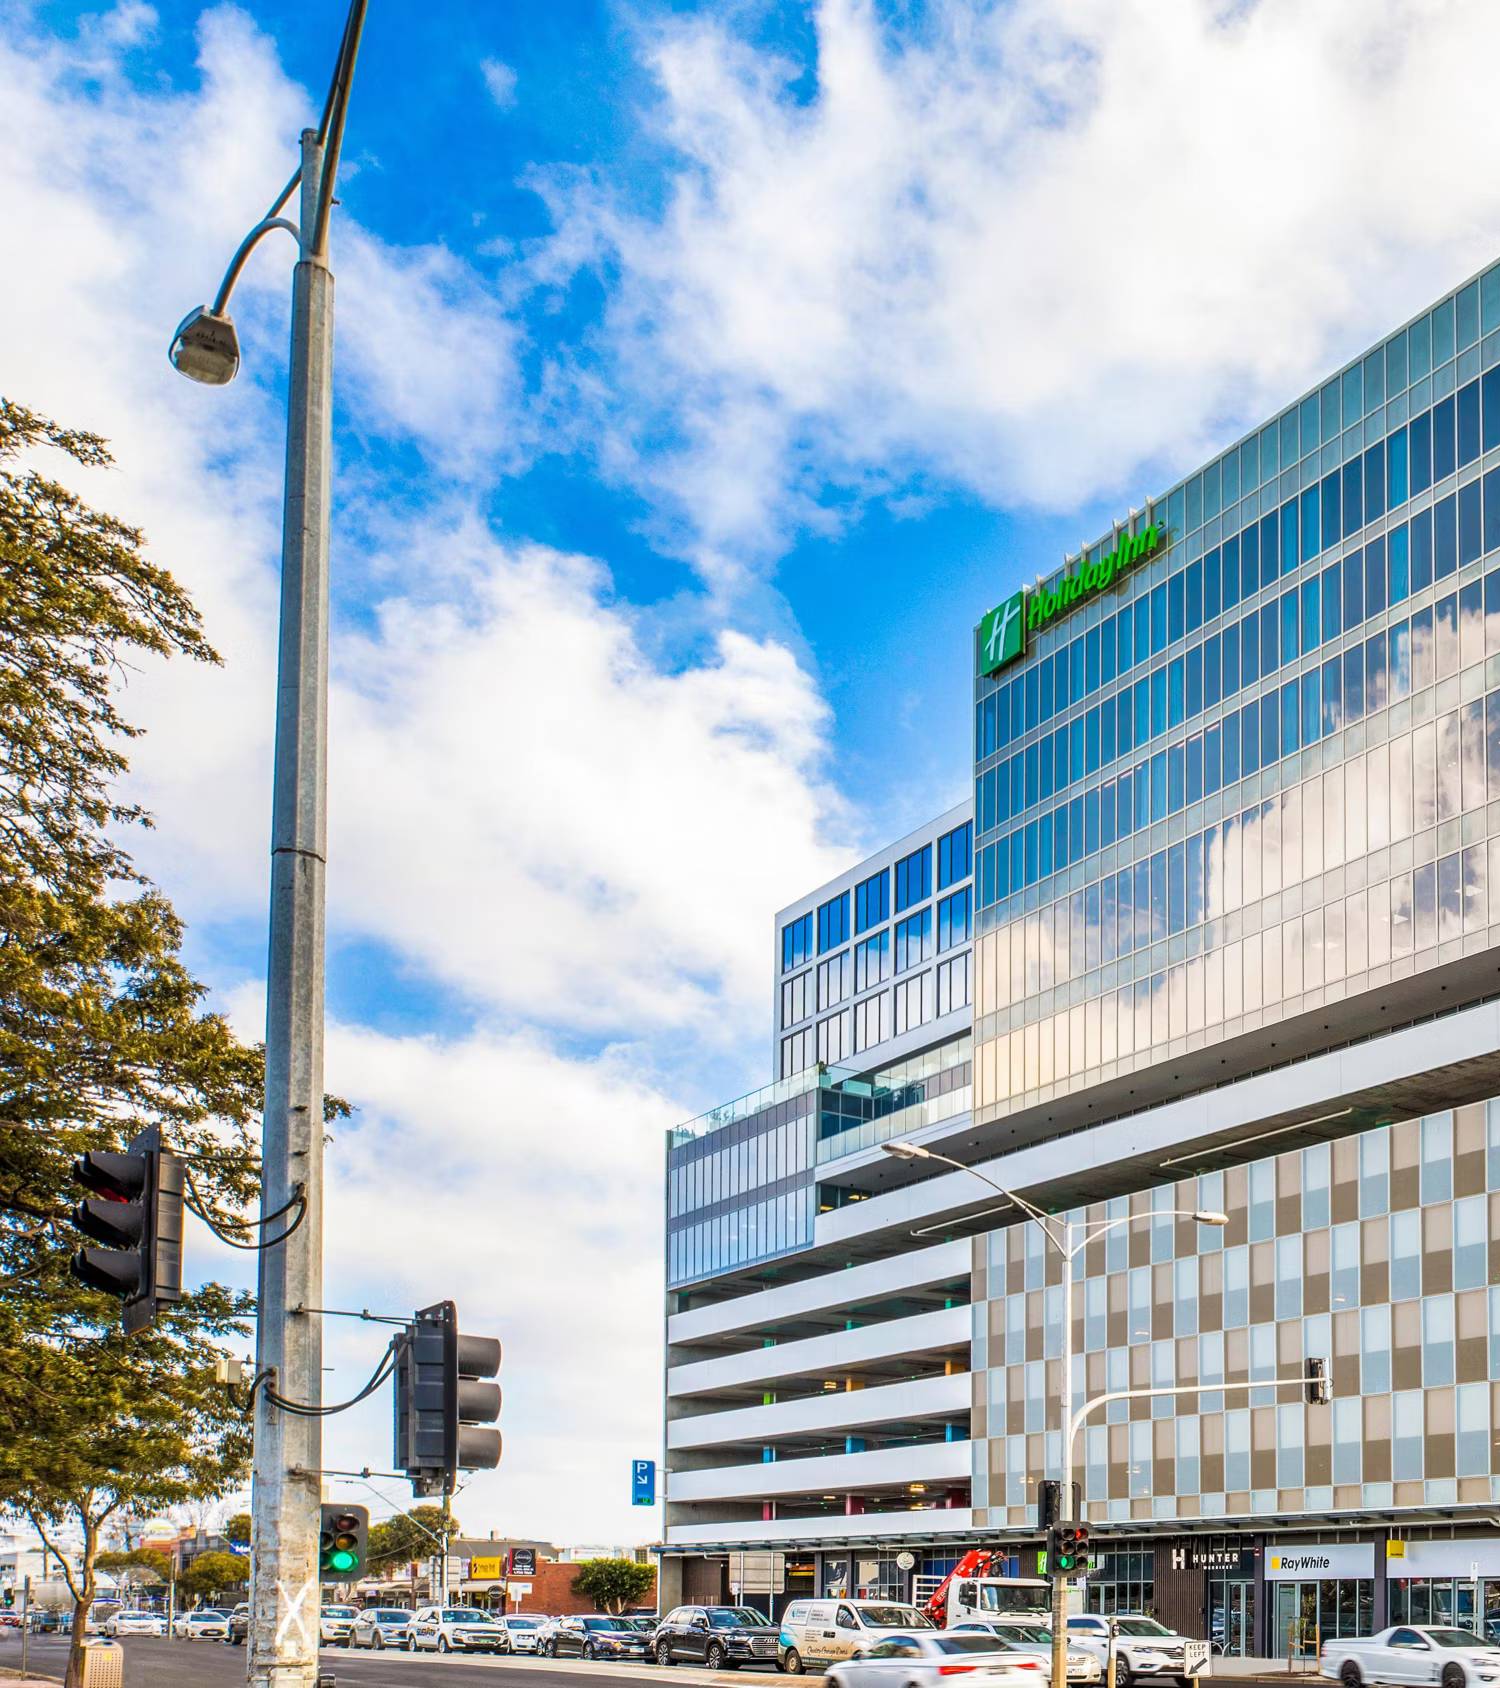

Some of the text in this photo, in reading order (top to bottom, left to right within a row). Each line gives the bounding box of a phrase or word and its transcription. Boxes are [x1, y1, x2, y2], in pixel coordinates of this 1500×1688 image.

[1027, 523, 1160, 630] Holiday Inn
[636, 1462, 648, 1474] P
[1192, 1553, 1239, 1564] HUNTER
[1280, 1556, 1330, 1571] RayWhite
